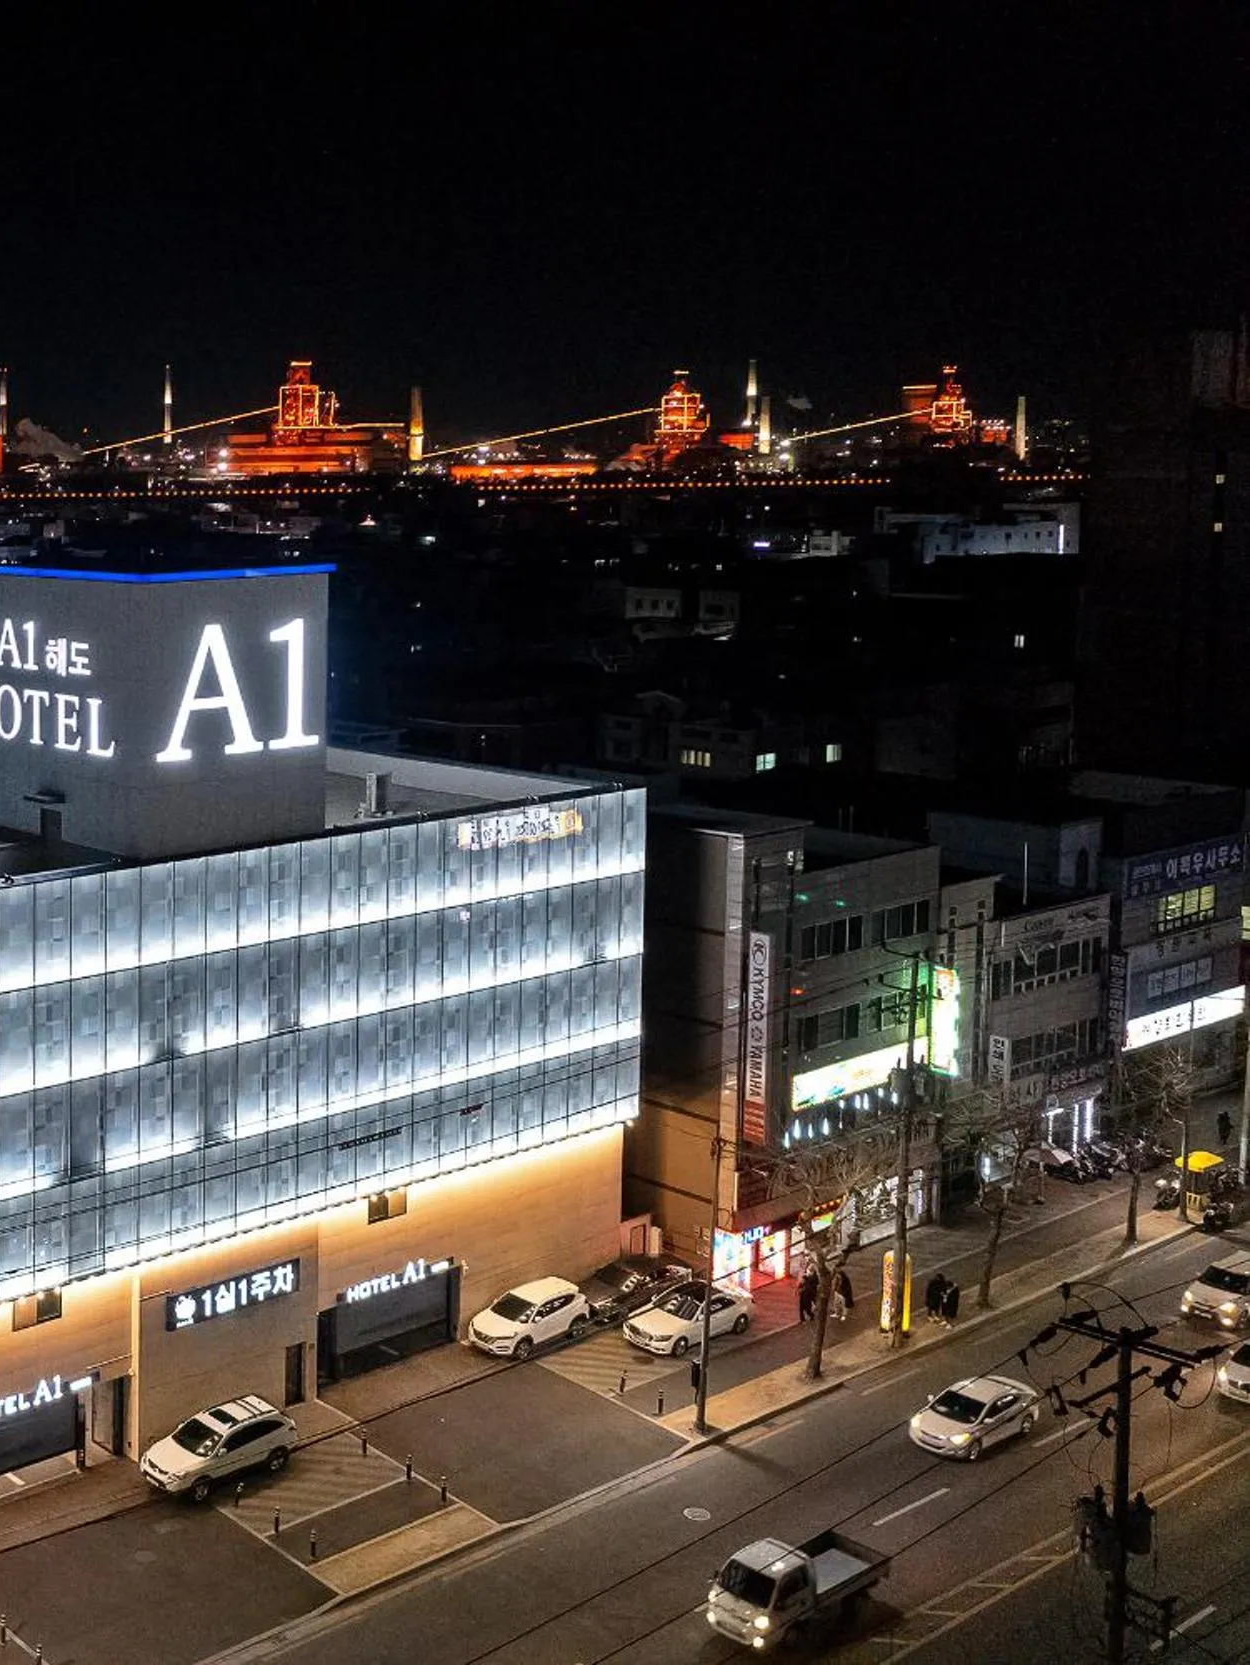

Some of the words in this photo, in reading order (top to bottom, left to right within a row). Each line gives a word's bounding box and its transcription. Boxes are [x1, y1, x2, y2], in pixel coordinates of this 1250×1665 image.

[156, 617, 320, 763] A1
[750, 966, 765, 1021] KYMCO
[749, 1045, 765, 1098] YAMAHA
[346, 1272, 401, 1304] HOTEL
[402, 1257, 426, 1285] A1
[34, 1374, 64, 1406] A1
